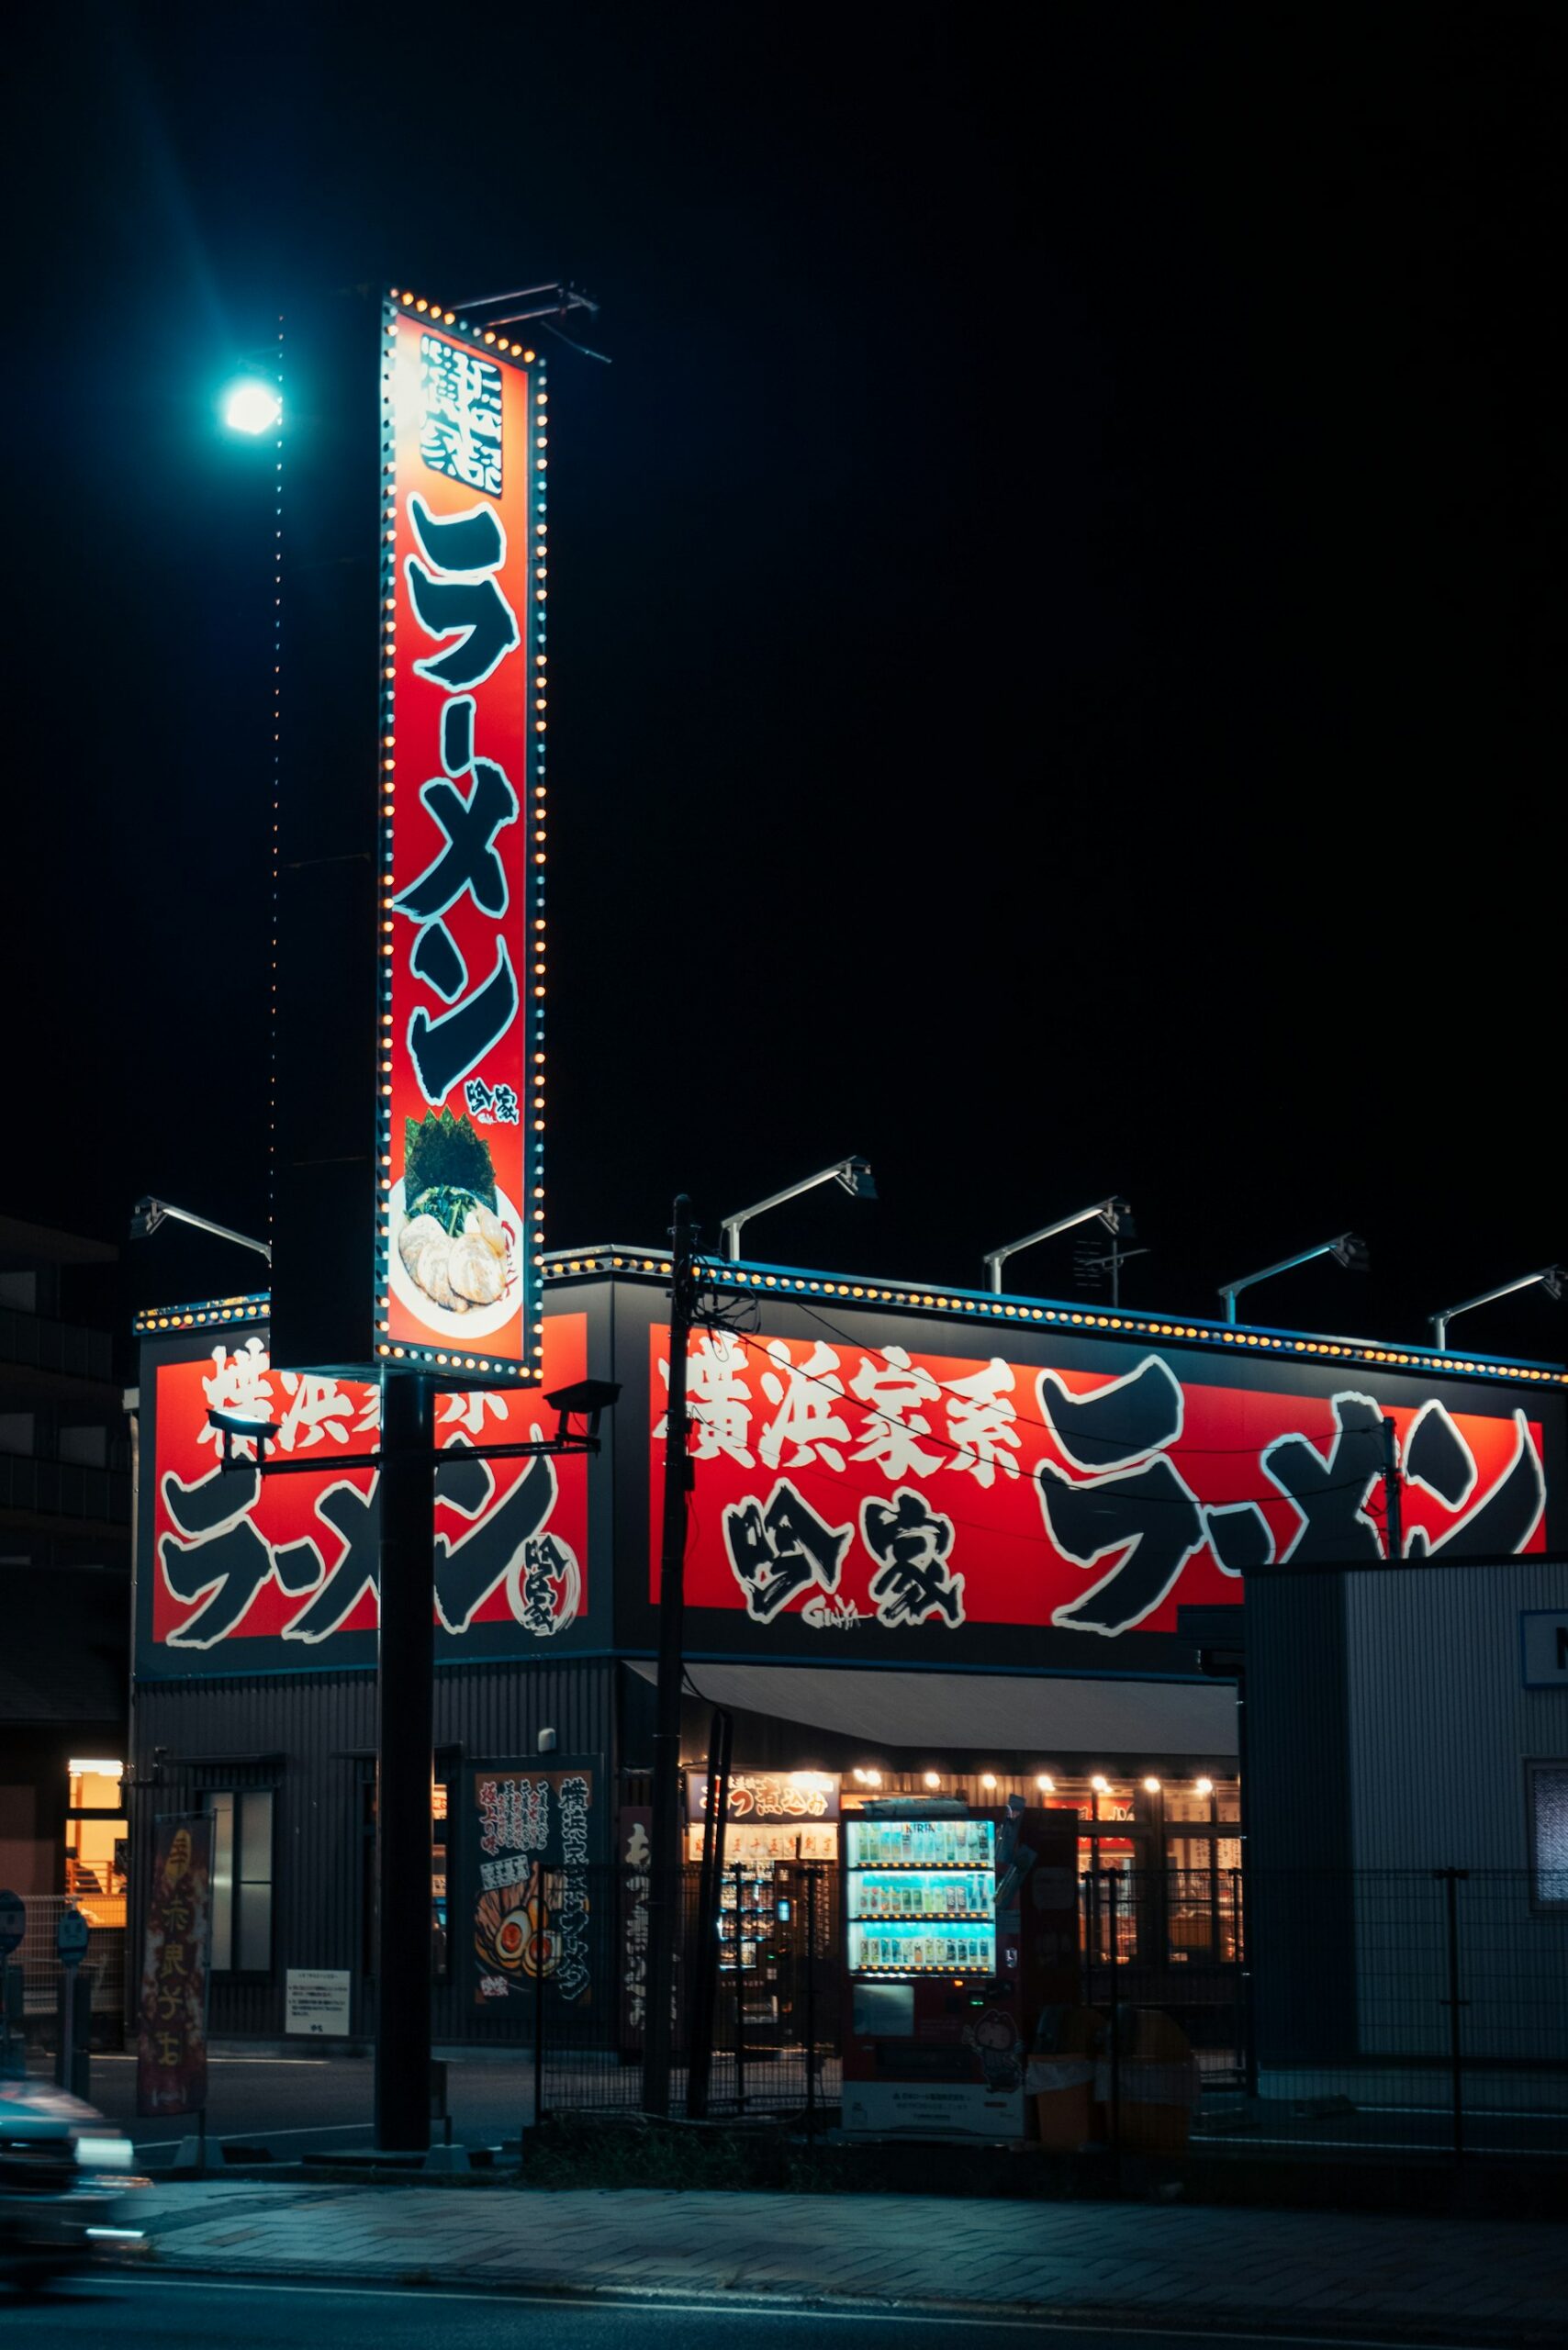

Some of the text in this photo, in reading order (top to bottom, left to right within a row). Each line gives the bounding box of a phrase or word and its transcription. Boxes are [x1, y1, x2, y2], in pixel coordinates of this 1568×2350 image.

[392, 491, 521, 1106] ラーメン
[652, 1330, 1022, 1488] 横浜家系
